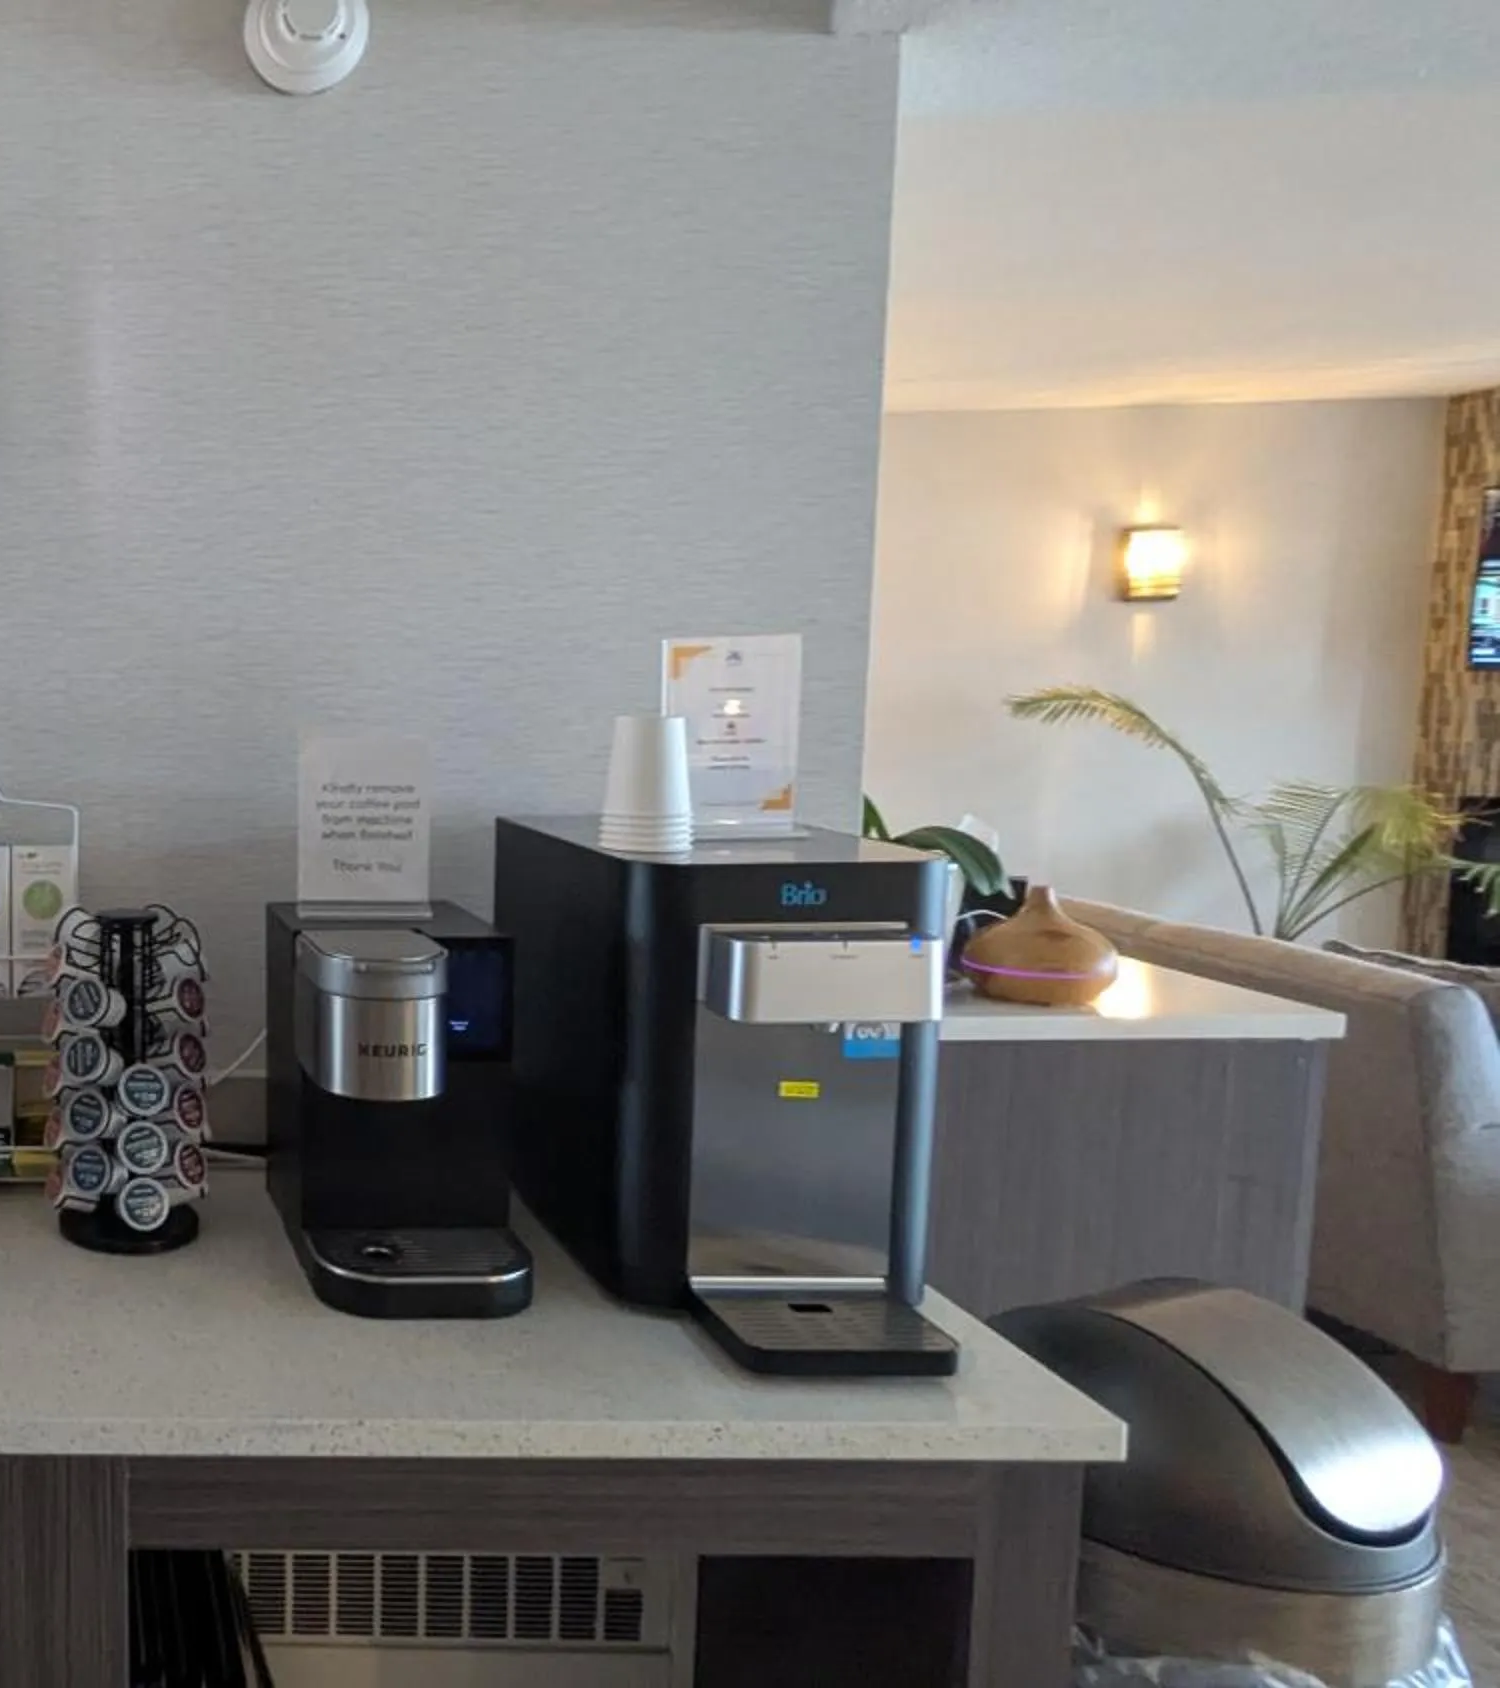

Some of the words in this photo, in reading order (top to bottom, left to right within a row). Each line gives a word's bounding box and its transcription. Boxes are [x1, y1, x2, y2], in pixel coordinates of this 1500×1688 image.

[366, 784, 416, 795] remove
[316, 799, 345, 812] your
[348, 798, 390, 810] coffee
[393, 798, 421, 812] pod
[356, 814, 413, 825] machine
[780, 880, 828, 906] Brio
[357, 1042, 428, 1058] KEURIG
